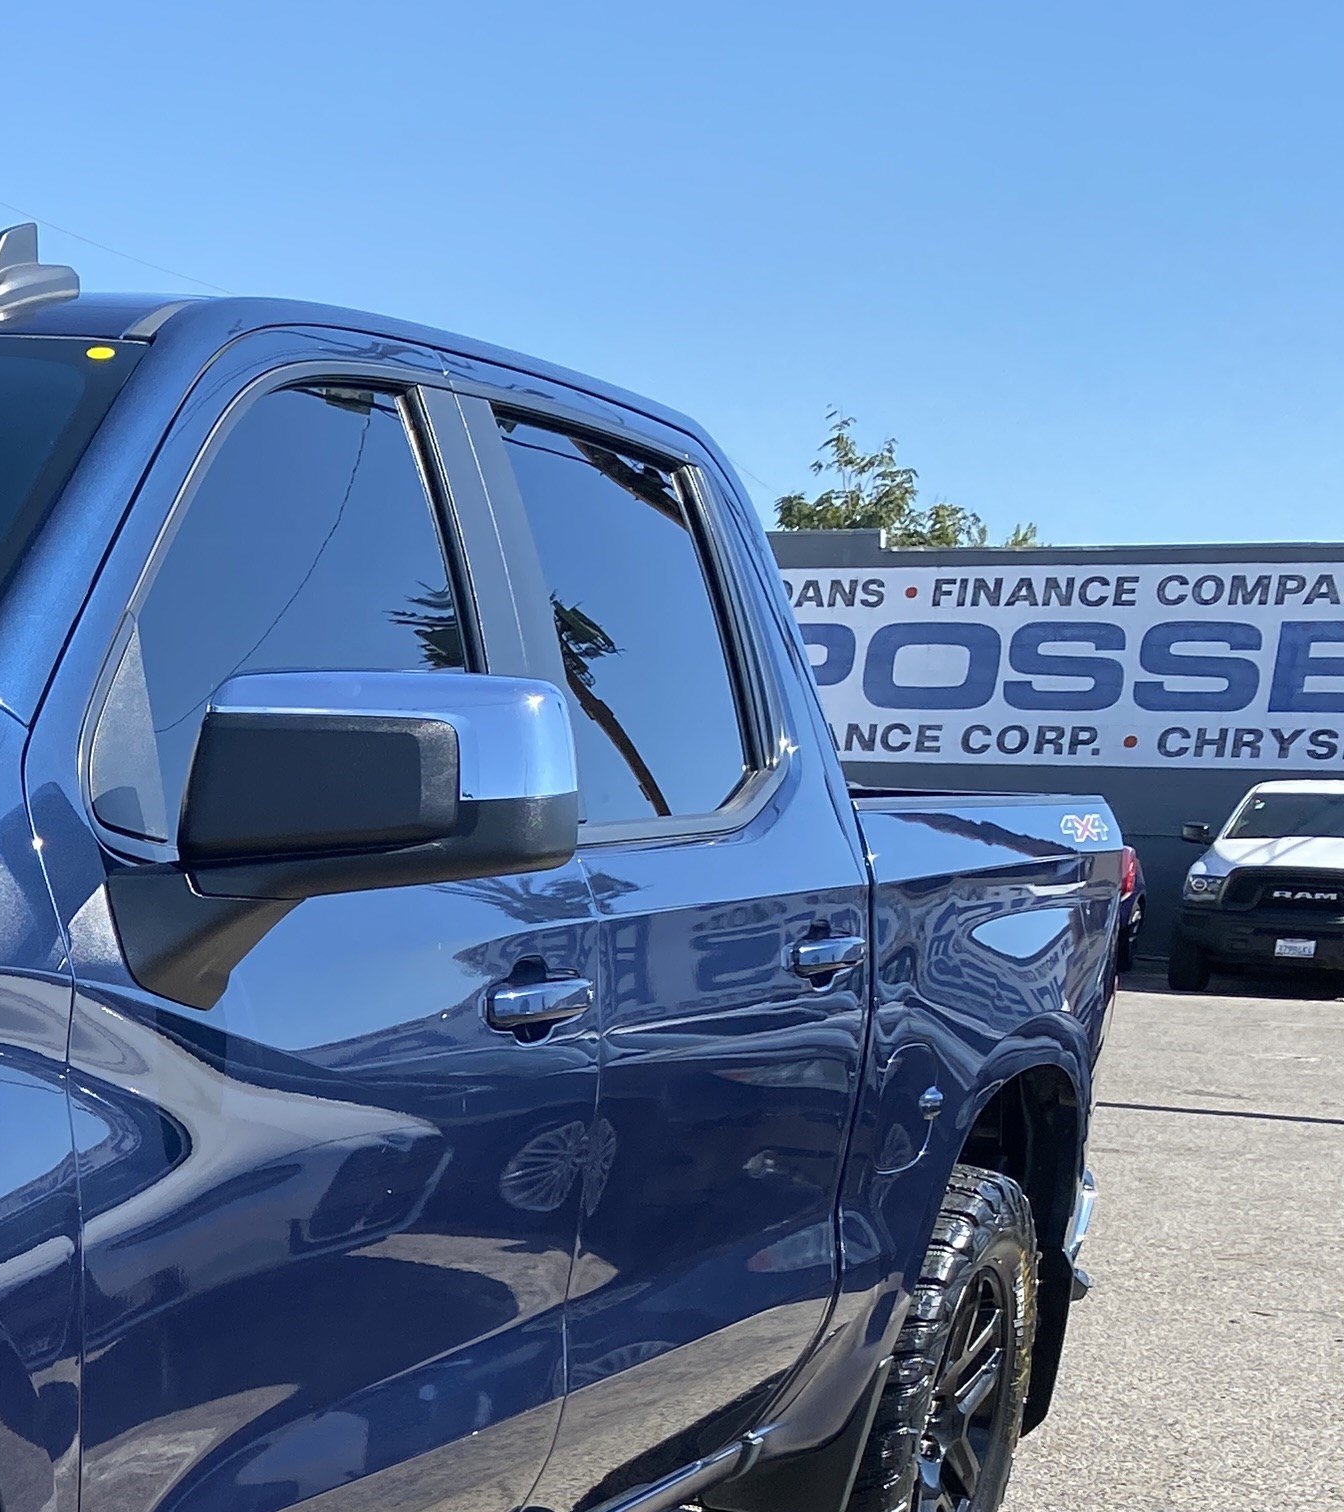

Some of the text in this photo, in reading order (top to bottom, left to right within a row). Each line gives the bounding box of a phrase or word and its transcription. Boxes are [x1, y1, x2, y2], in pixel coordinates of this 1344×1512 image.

[783, 574, 1341, 607] ANS FINANCE COMPA
[829, 722, 944, 753] NCE
[961, 724, 1100, 756] CORP.
[1273, 890, 1338, 900] RAM
